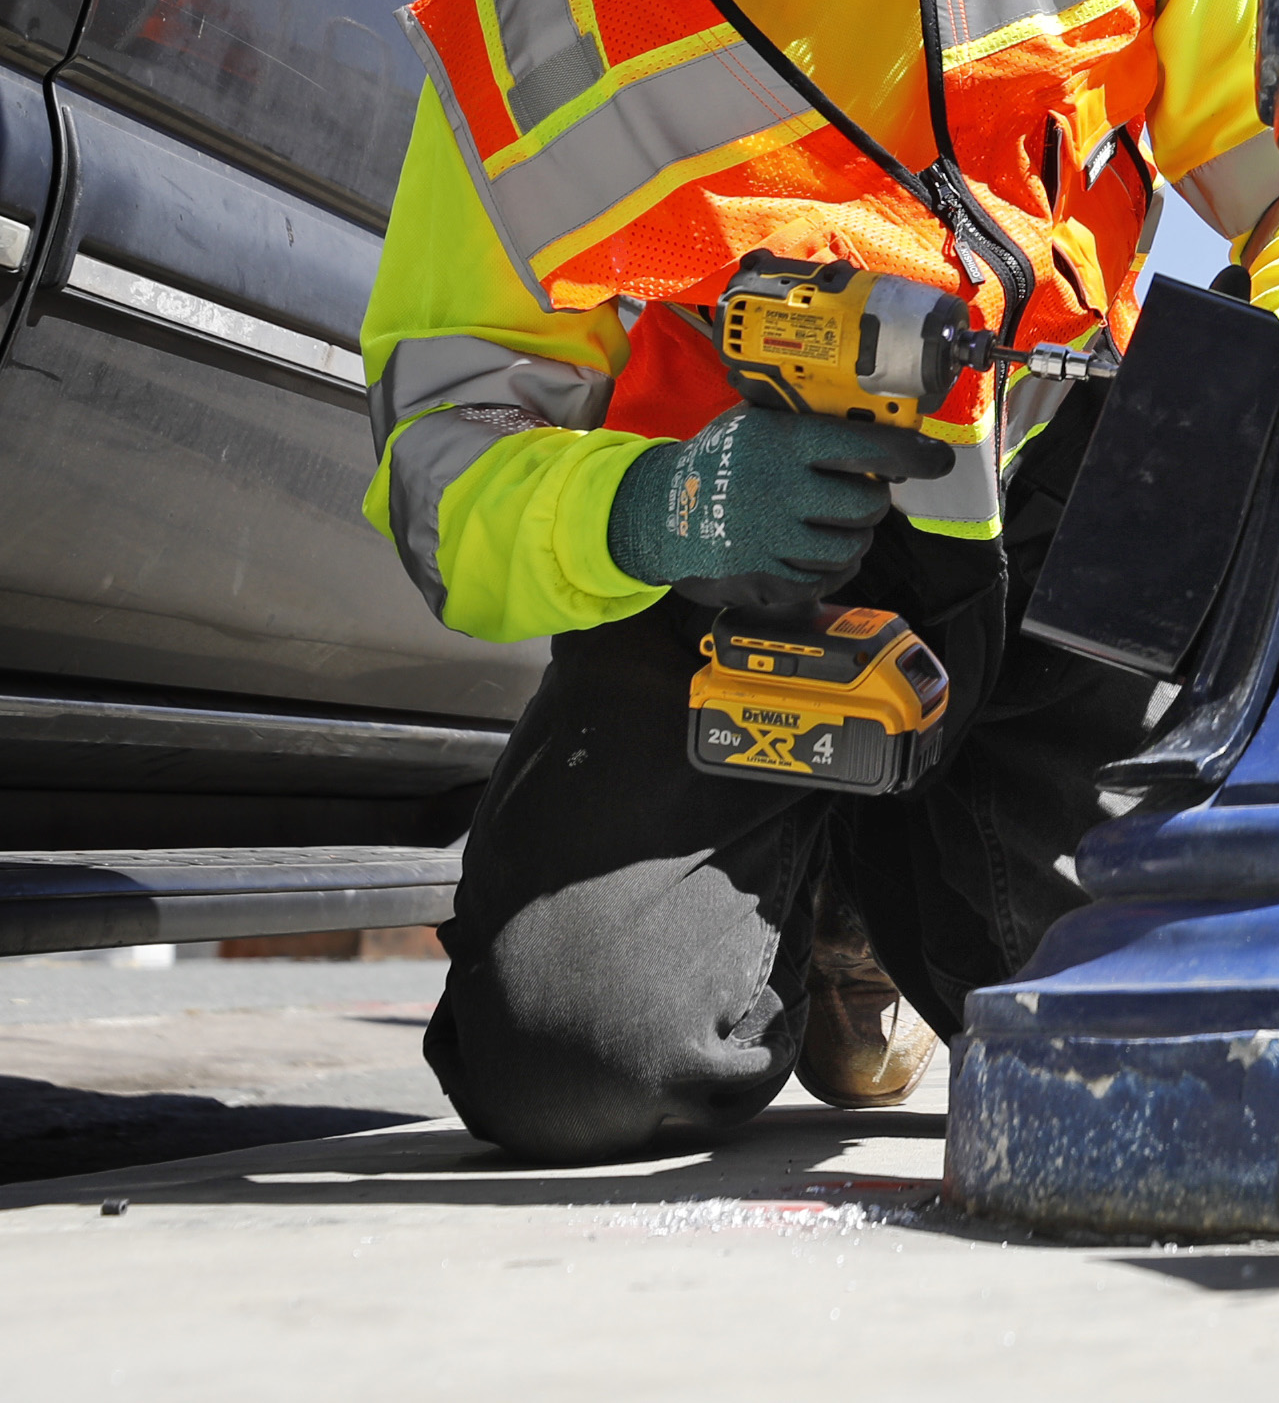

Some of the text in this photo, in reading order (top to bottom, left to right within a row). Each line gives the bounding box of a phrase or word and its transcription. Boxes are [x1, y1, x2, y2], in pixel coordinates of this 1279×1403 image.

[960, 248, 981, 279] KISHIGO
[744, 726, 796, 761] XR
[812, 733, 834, 759] 4
[747, 756, 792, 767] LITHIUM ION
